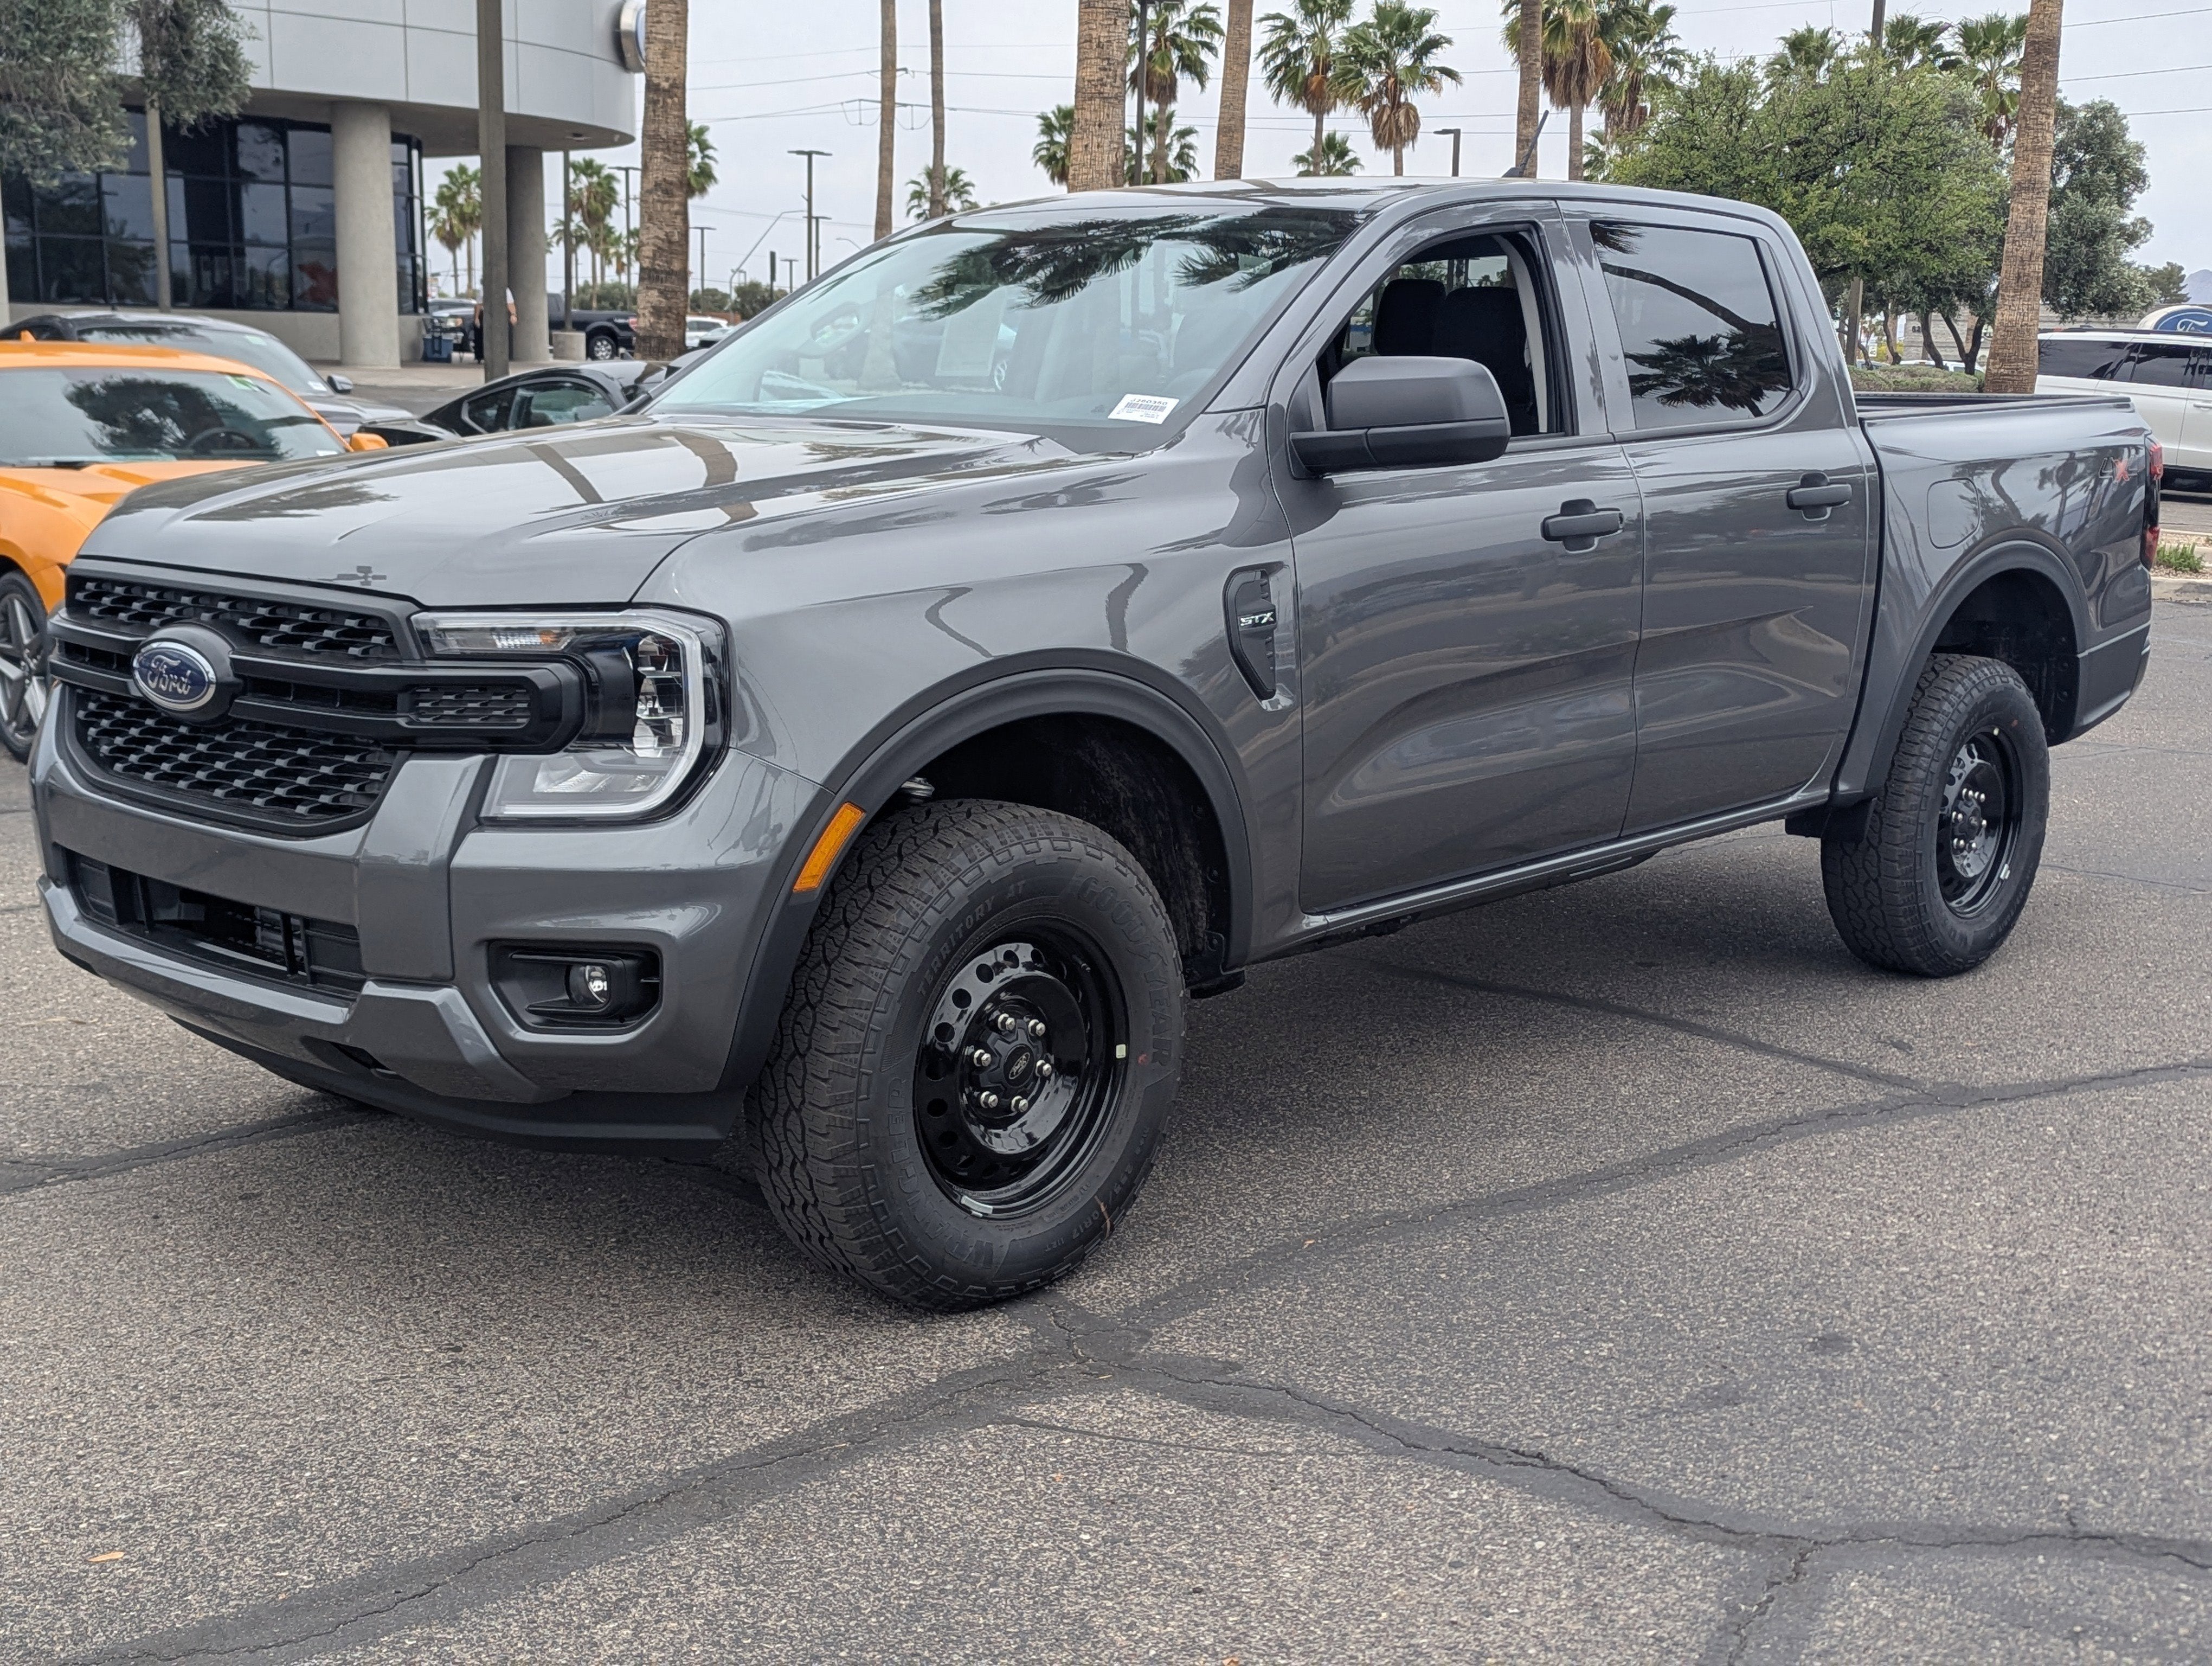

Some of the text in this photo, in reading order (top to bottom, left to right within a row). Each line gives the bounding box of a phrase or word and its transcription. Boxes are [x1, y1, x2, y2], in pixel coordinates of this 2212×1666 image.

[1240, 611, 1275, 626] STX
[147, 655, 192, 695] Ford
[916, 895, 996, 997] TERRITORY
